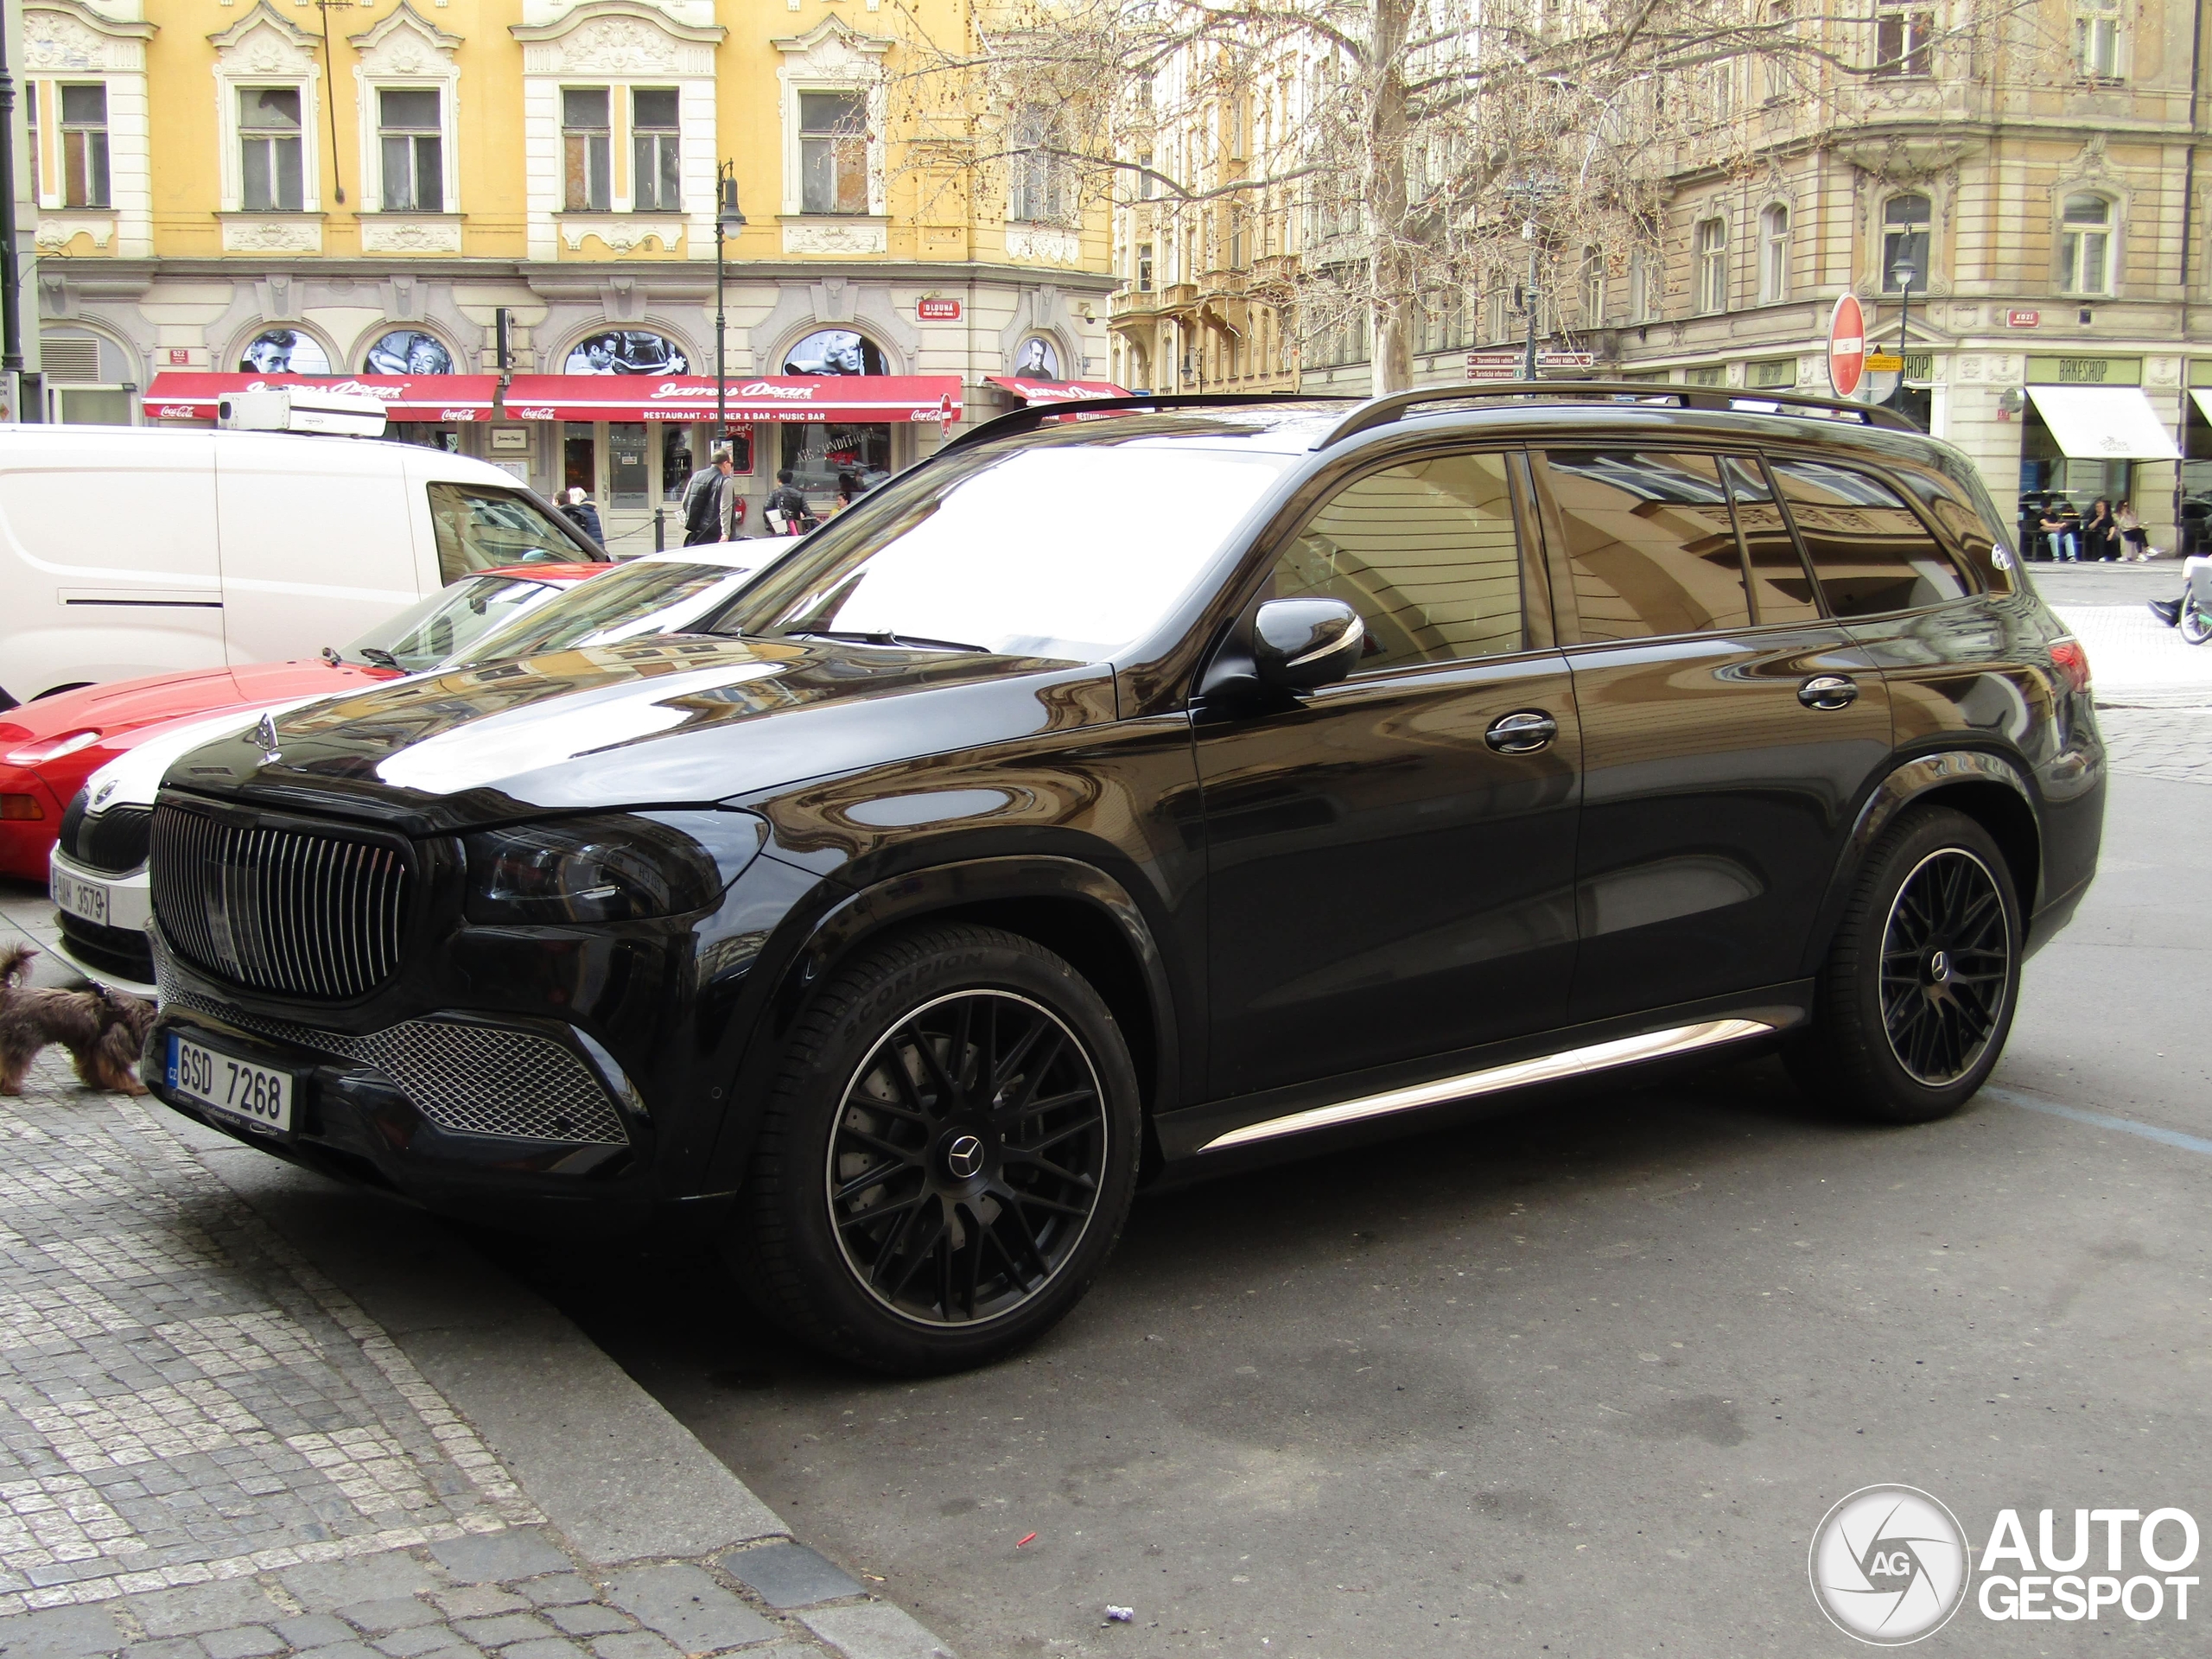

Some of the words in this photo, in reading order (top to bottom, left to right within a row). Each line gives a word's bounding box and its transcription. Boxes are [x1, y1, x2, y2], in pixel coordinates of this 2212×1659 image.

[2059, 359, 2107, 382] BAKESHOP
[741, 382, 814, 396] Dean
[1014, 383, 1070, 398] James
[779, 412, 804, 421] MUSIC
[77, 885, 103, 919] 3579
[168, 1066, 177, 1080] CZ
[181, 1044, 213, 1095] 6SD
[226, 1061, 281, 1120] 7268
